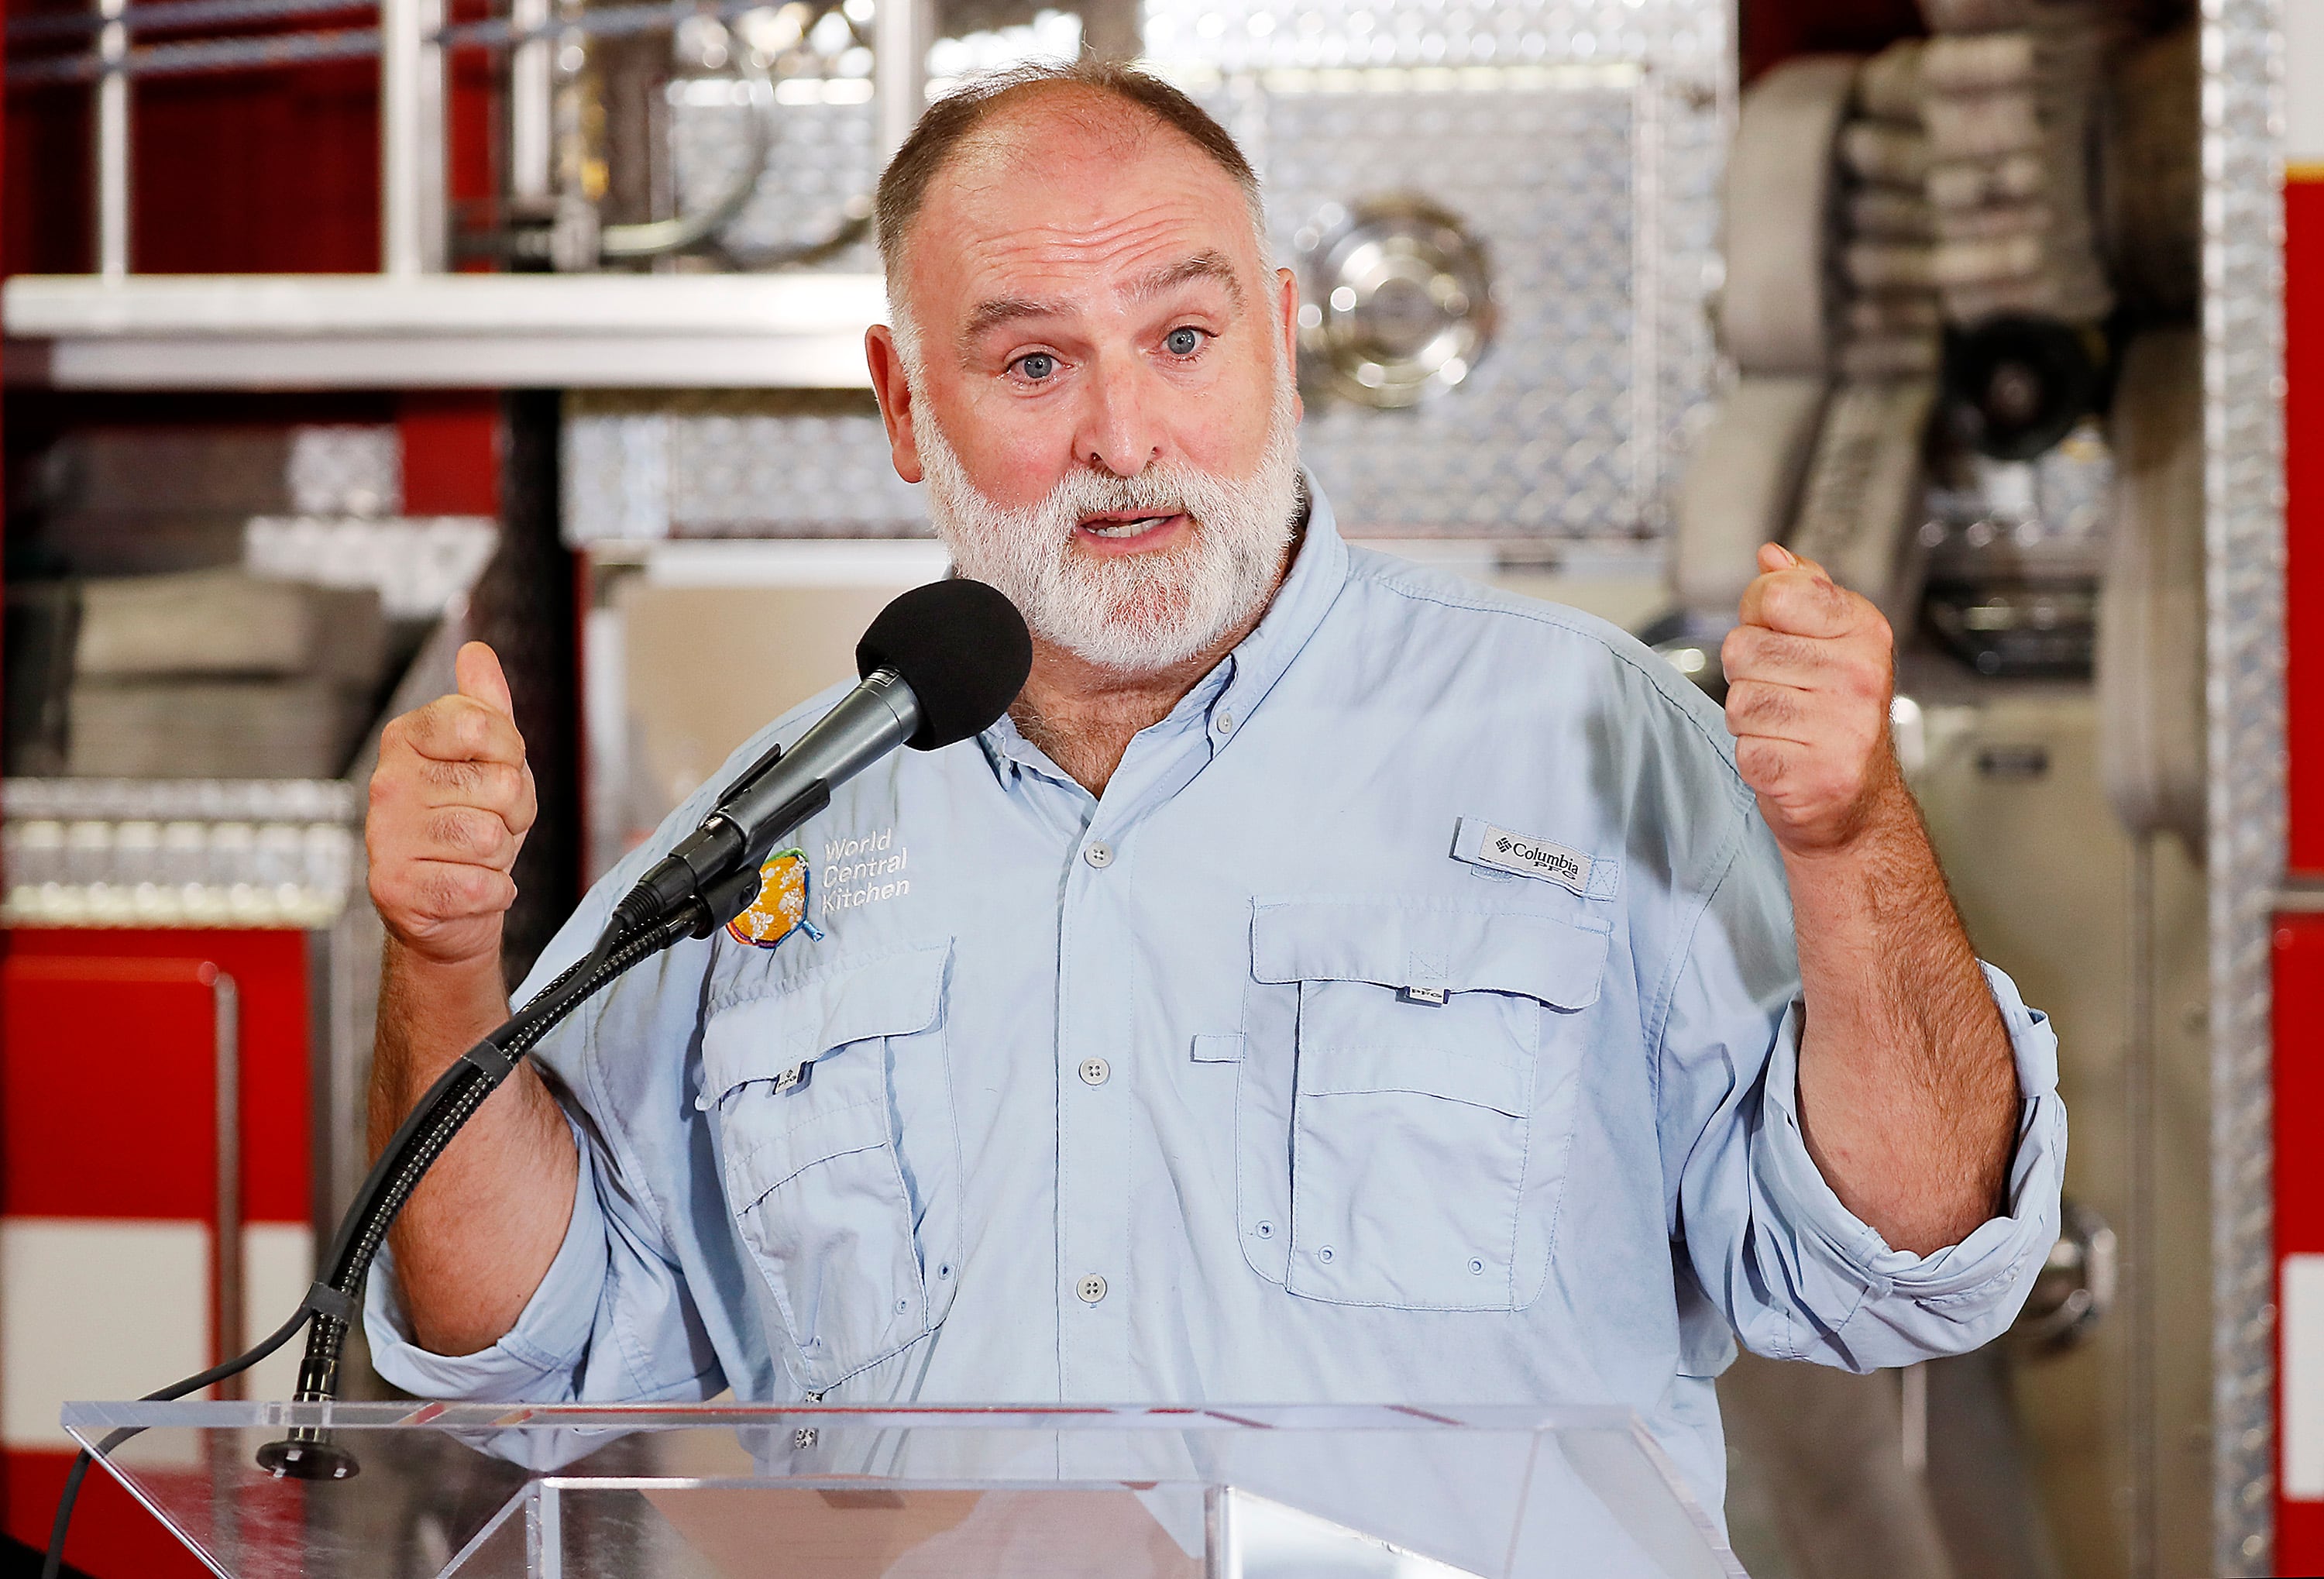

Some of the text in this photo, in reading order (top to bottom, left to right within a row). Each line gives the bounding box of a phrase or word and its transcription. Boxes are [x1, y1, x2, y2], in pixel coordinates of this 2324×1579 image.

[824, 827, 892, 862] World
[1513, 842, 1579, 875] Columbia
[823, 847, 907, 889] Central
[1534, 861, 1576, 880] PFG
[821, 879, 910, 915] Kitchen
